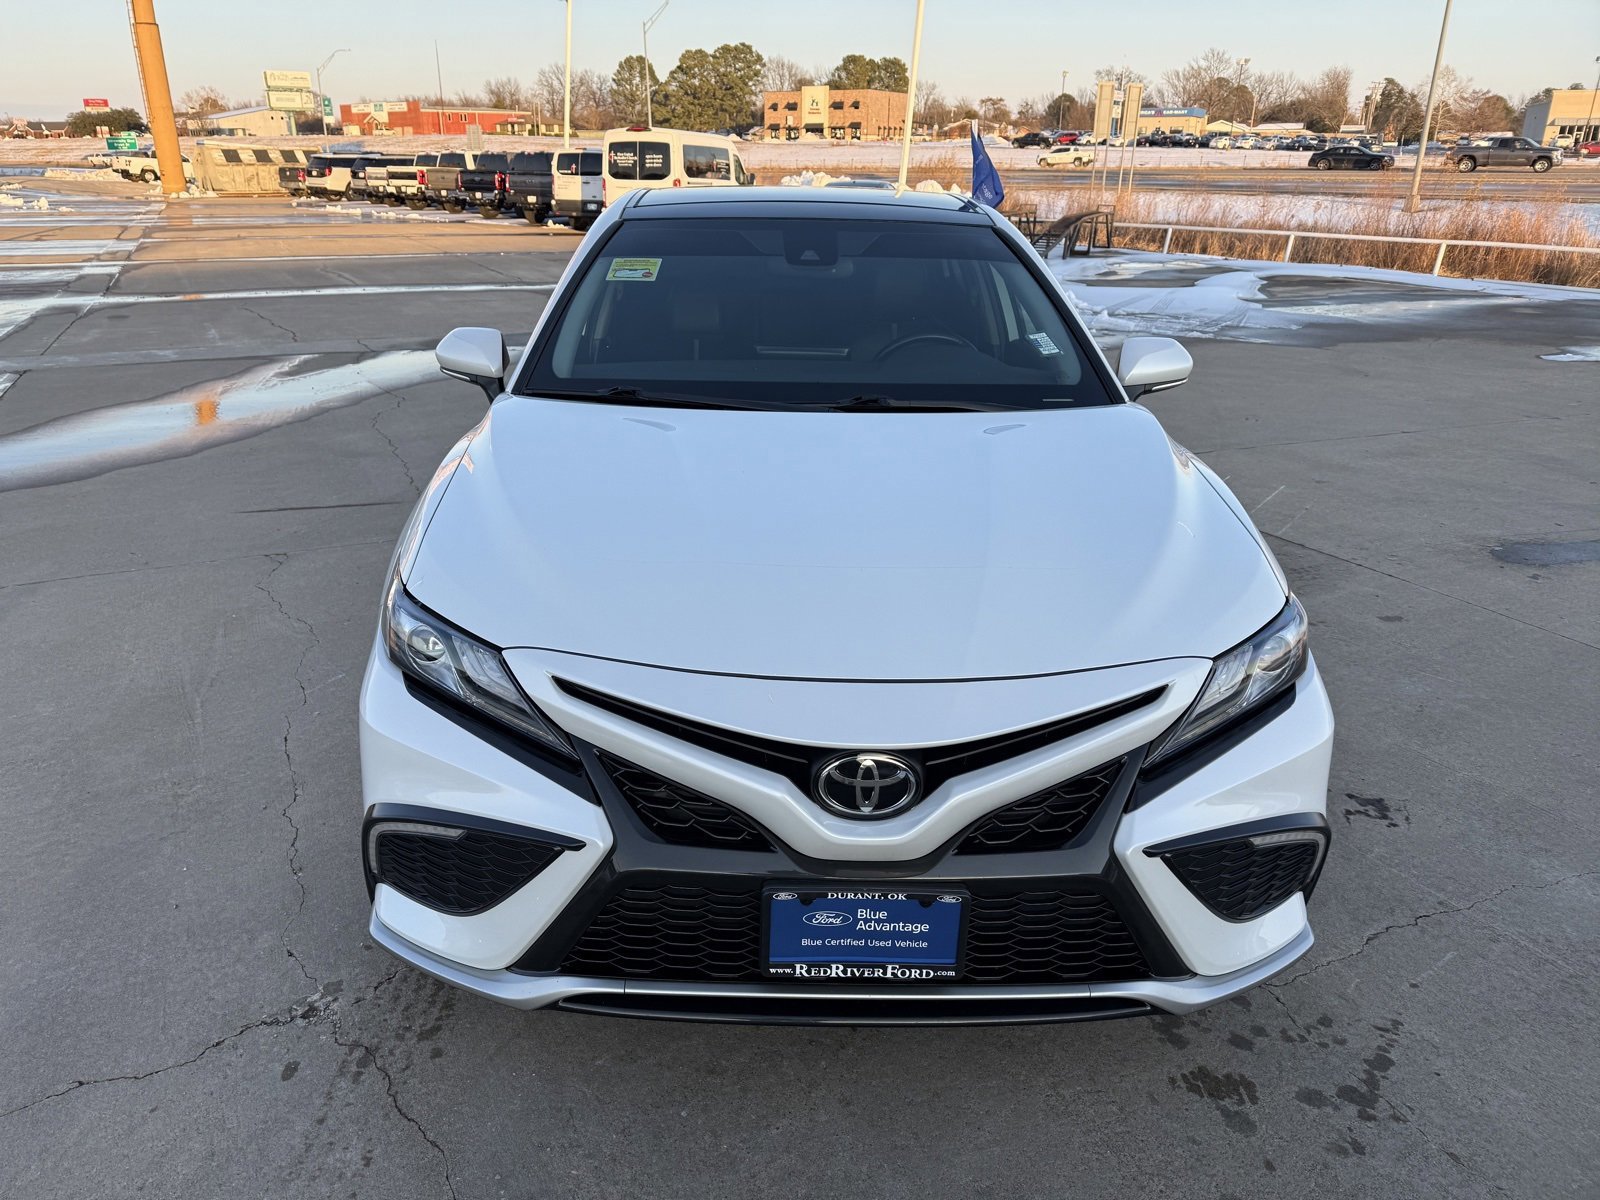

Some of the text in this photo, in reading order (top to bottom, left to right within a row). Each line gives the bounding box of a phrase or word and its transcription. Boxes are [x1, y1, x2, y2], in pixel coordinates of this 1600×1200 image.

[828, 892, 908, 901] DURANT, OK
[811, 912, 844, 925] Ford
[857, 909, 888, 919] Blue
[856, 920, 930, 934] Advantage
[801, 938, 928, 948] Blue Certified Used Vehicle
